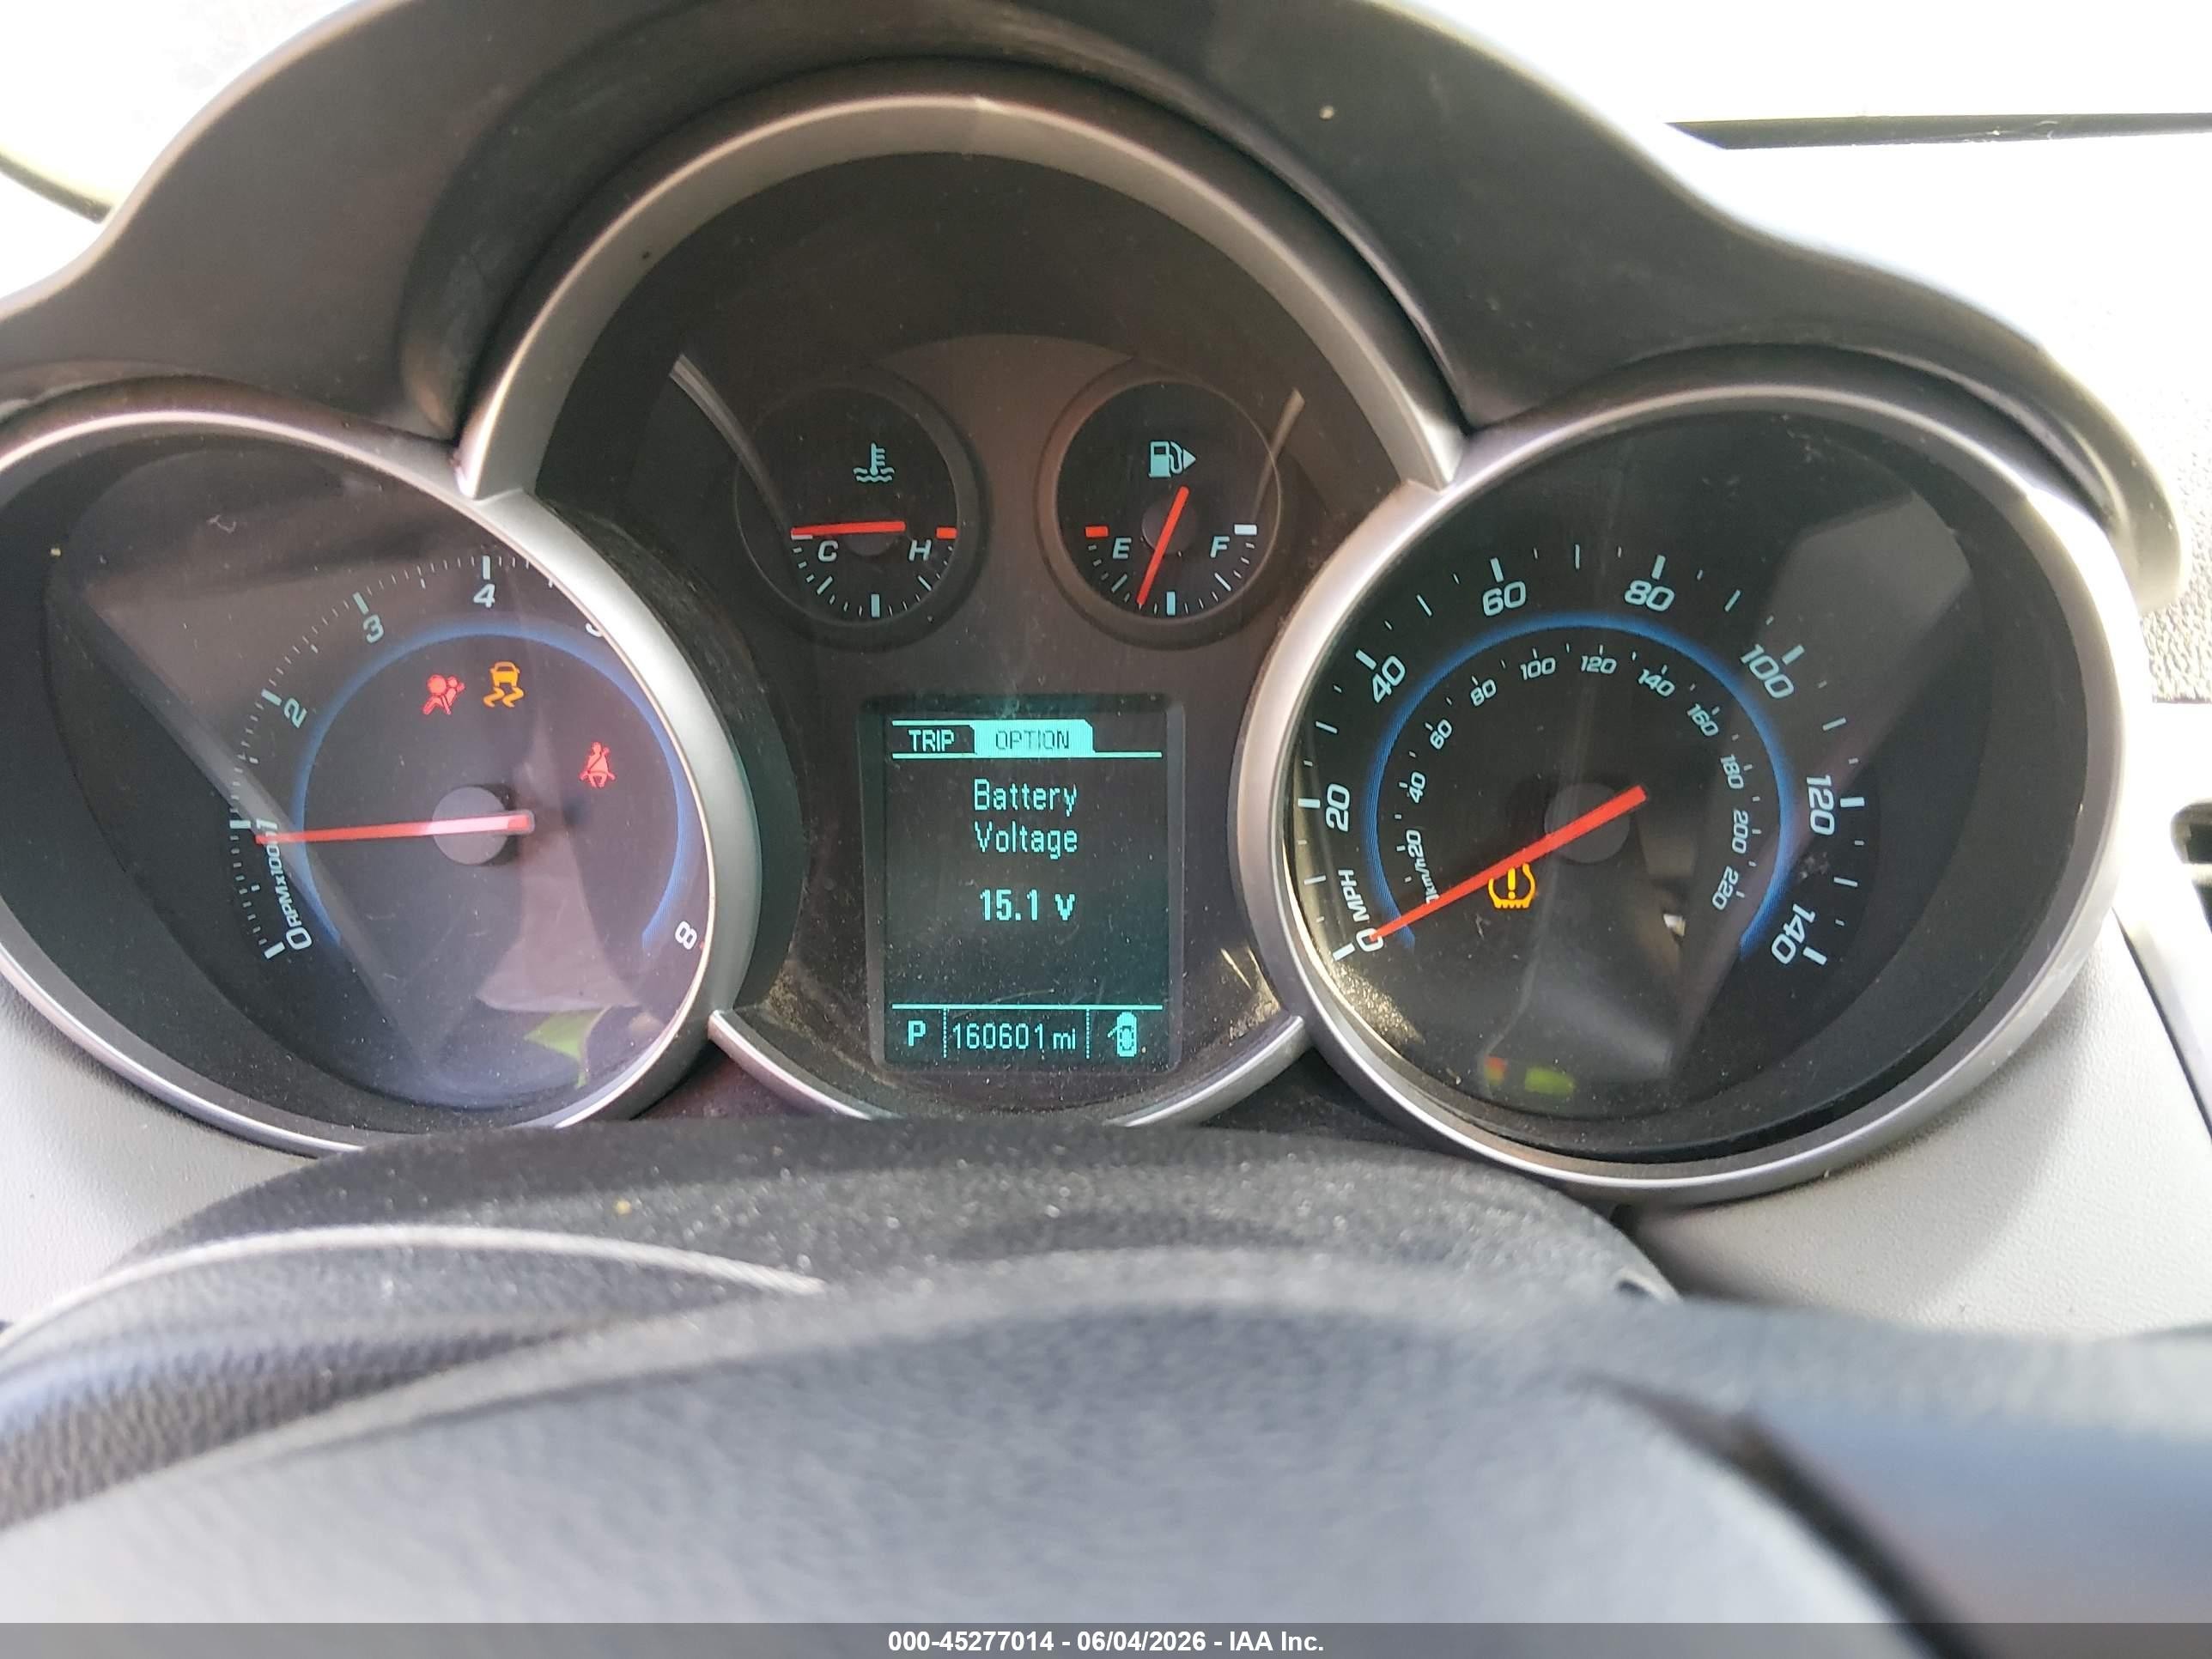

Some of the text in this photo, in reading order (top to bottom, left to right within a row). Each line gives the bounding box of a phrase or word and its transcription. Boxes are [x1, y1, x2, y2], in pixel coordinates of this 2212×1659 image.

[817, 540, 839, 562] C
[908, 539, 932, 562] H
[1112, 538, 1133, 560] E
[1210, 536, 1231, 558] F
[473, 584, 495, 609] 4
[1482, 580, 1527, 617] 60
[1625, 580, 1675, 612] 80
[362, 616, 385, 644] 3
[1372, 655, 1407, 703] 40
[1520, 657, 1556, 681] 100
[1581, 655, 1617, 675] 120
[1739, 644, 1795, 699] 100
[1470, 678, 1497, 707] 80
[1638, 669, 1675, 698] 140
[283, 697, 307, 728] 2
[1687, 703, 1720, 737] 160
[908, 729, 1071, 752] TRIP OPTION
[1430, 719, 1453, 750] 60
[1720, 754, 1744, 790] 180
[973, 778, 1079, 817] Battery
[1408, 771, 1426, 804] 40
[1325, 783, 1351, 832] 20
[1806, 775, 1836, 836] 120
[255, 817, 278, 830] 1
[1731, 809, 1749, 854] 200
[973, 820, 1079, 860] Voltage
[1406, 830, 1424, 858] 20
[1338, 869, 1370, 923] MPH
[1712, 866, 1740, 911] 220
[980, 889, 1039, 921] 15.1
[286, 927, 313, 951] 0
[674, 921, 698, 951] 8
[1356, 927, 1384, 952] 0
[1771, 903, 1816, 965] 140
[908, 1020, 927, 1047] P
[952, 1022, 1077, 1050] 160601 mi
